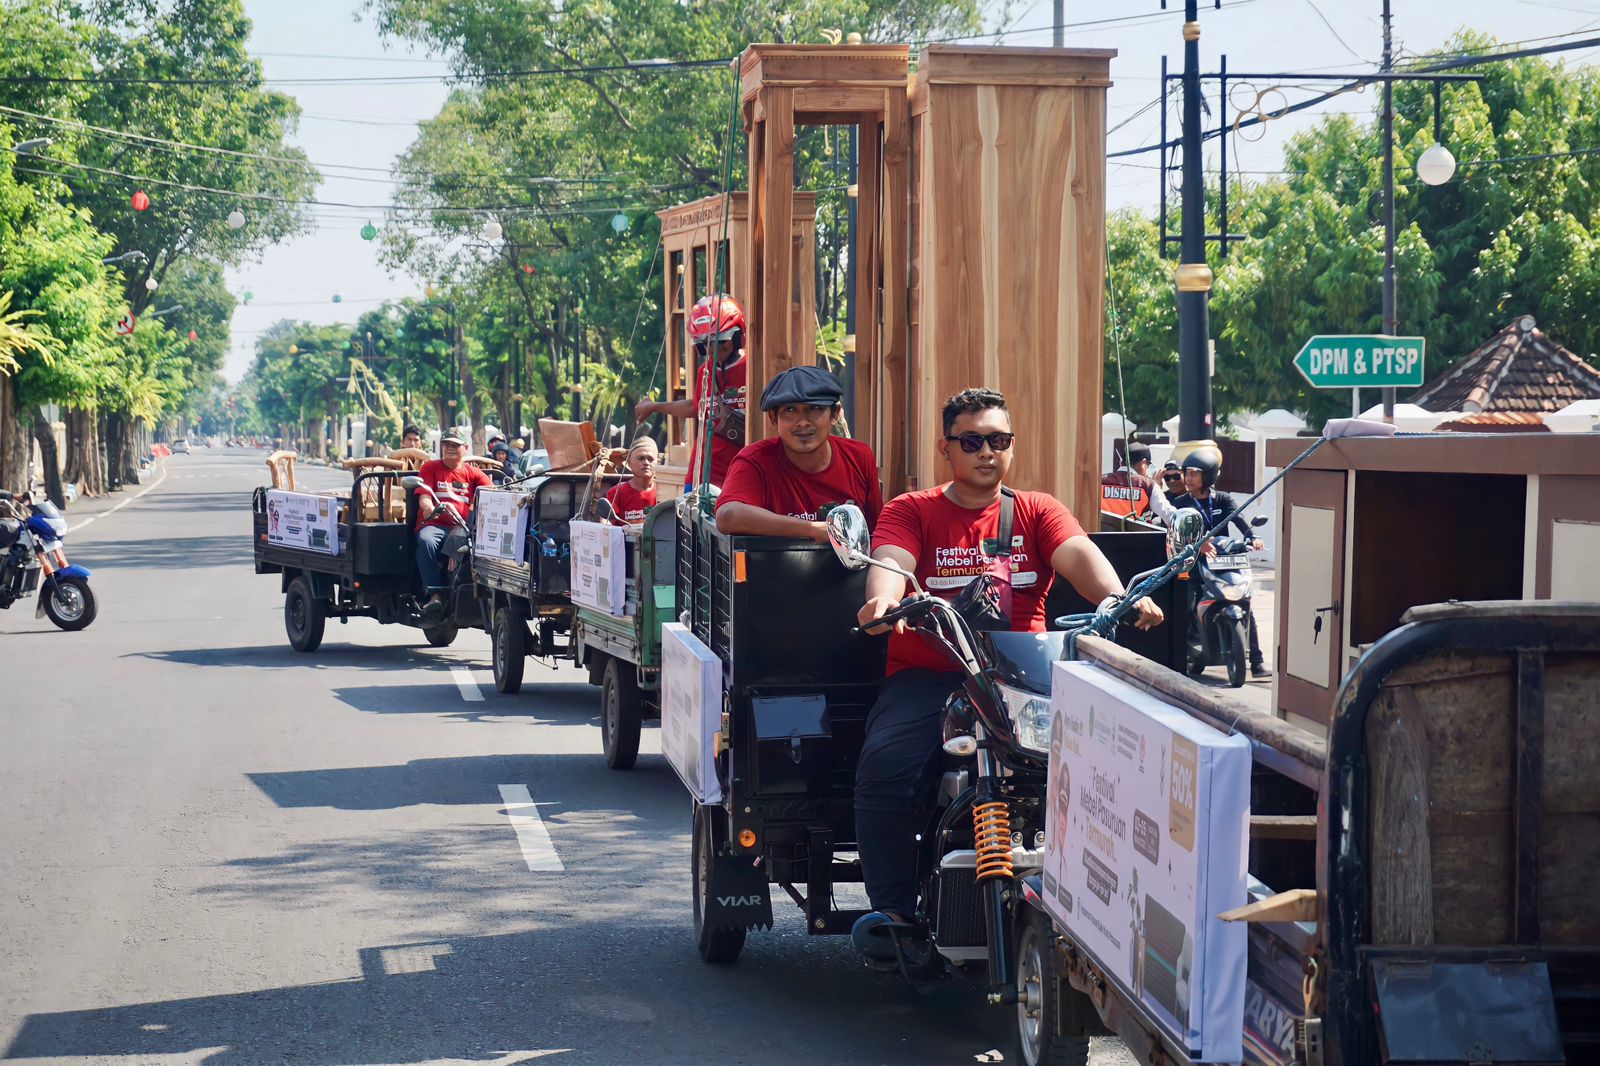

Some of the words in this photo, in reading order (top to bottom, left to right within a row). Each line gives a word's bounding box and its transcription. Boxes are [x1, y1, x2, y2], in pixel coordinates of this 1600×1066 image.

[1309, 348, 1349, 375] DPM
[1353, 347, 1367, 375] &
[1372, 347, 1418, 374] PTSP
[936, 546, 979, 557] Festival
[936, 555, 973, 567] Mebel
[1092, 766, 1116, 804] Festival
[1171, 760, 1193, 811] 50%
[1080, 785, 1098, 818] Mebel
[1098, 797, 1126, 841] Pasuruan
[717, 895, 761, 907] VIAR
